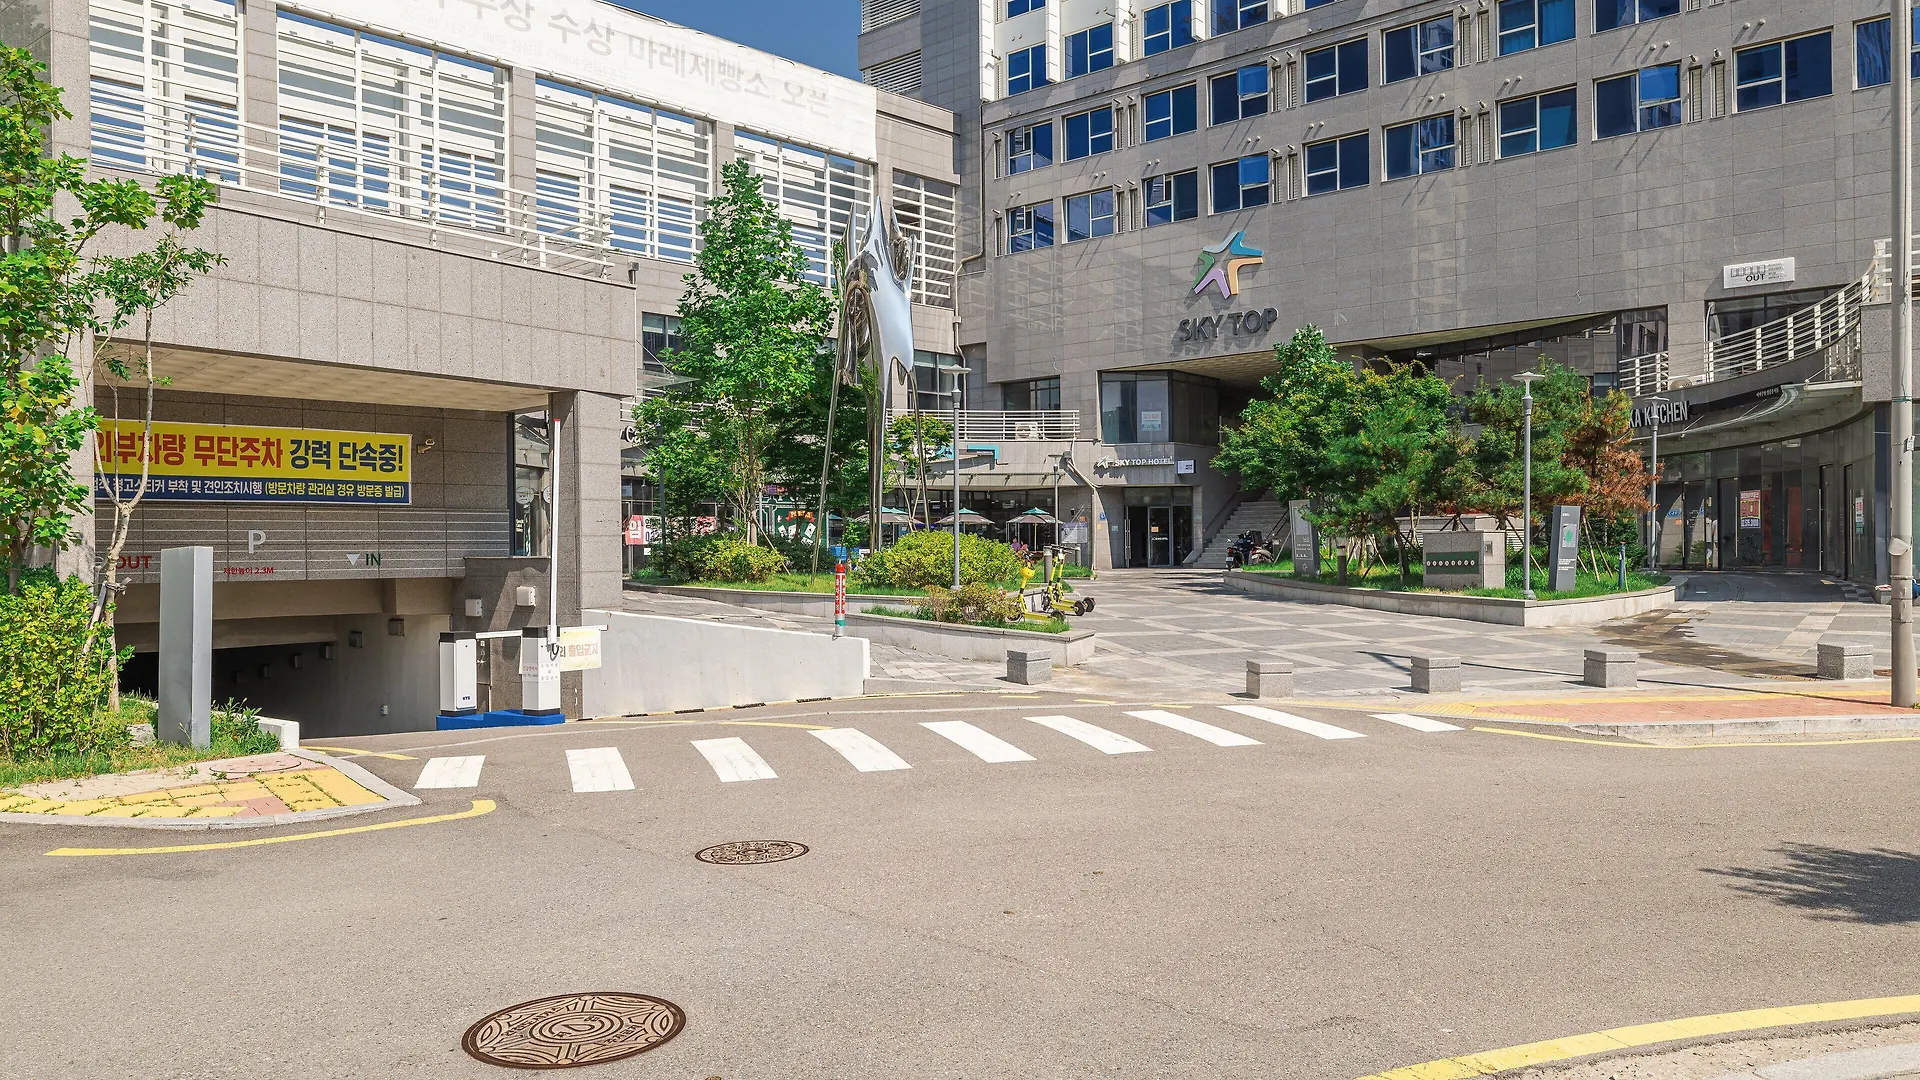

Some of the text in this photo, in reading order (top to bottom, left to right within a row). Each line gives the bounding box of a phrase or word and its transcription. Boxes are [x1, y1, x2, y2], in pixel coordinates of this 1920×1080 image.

[548, 7, 615, 56] 수상
[628, 34, 771, 99] 마레제빵소
[781, 81, 830, 117] 오픈
[1179, 307, 1278, 341] SKY TOP
[194, 435, 284, 469] 무단주차
[289, 439, 331, 470] 강력
[338, 441, 403, 473] 단속중!
[1115, 459, 1130, 467] SKY
[1148, 457, 1173, 465] HOTEL
[168, 480, 188, 495] 부착
[191, 481, 202, 495] 및
[204, 481, 263, 496] 견인조치시행
[264, 481, 306, 496] (방문차량
[307, 483, 335, 496] 관리실
[337, 483, 355, 497] 경유
[357, 484, 383, 498] 방문증
[385, 485, 405, 498] 발급)
[248, 529, 267, 554] P
[116, 555, 152, 570] OUT
[365, 553, 381, 567] IN
[254, 567, 274, 575] 2.3M
[568, 643, 599, 658] 출입금지
